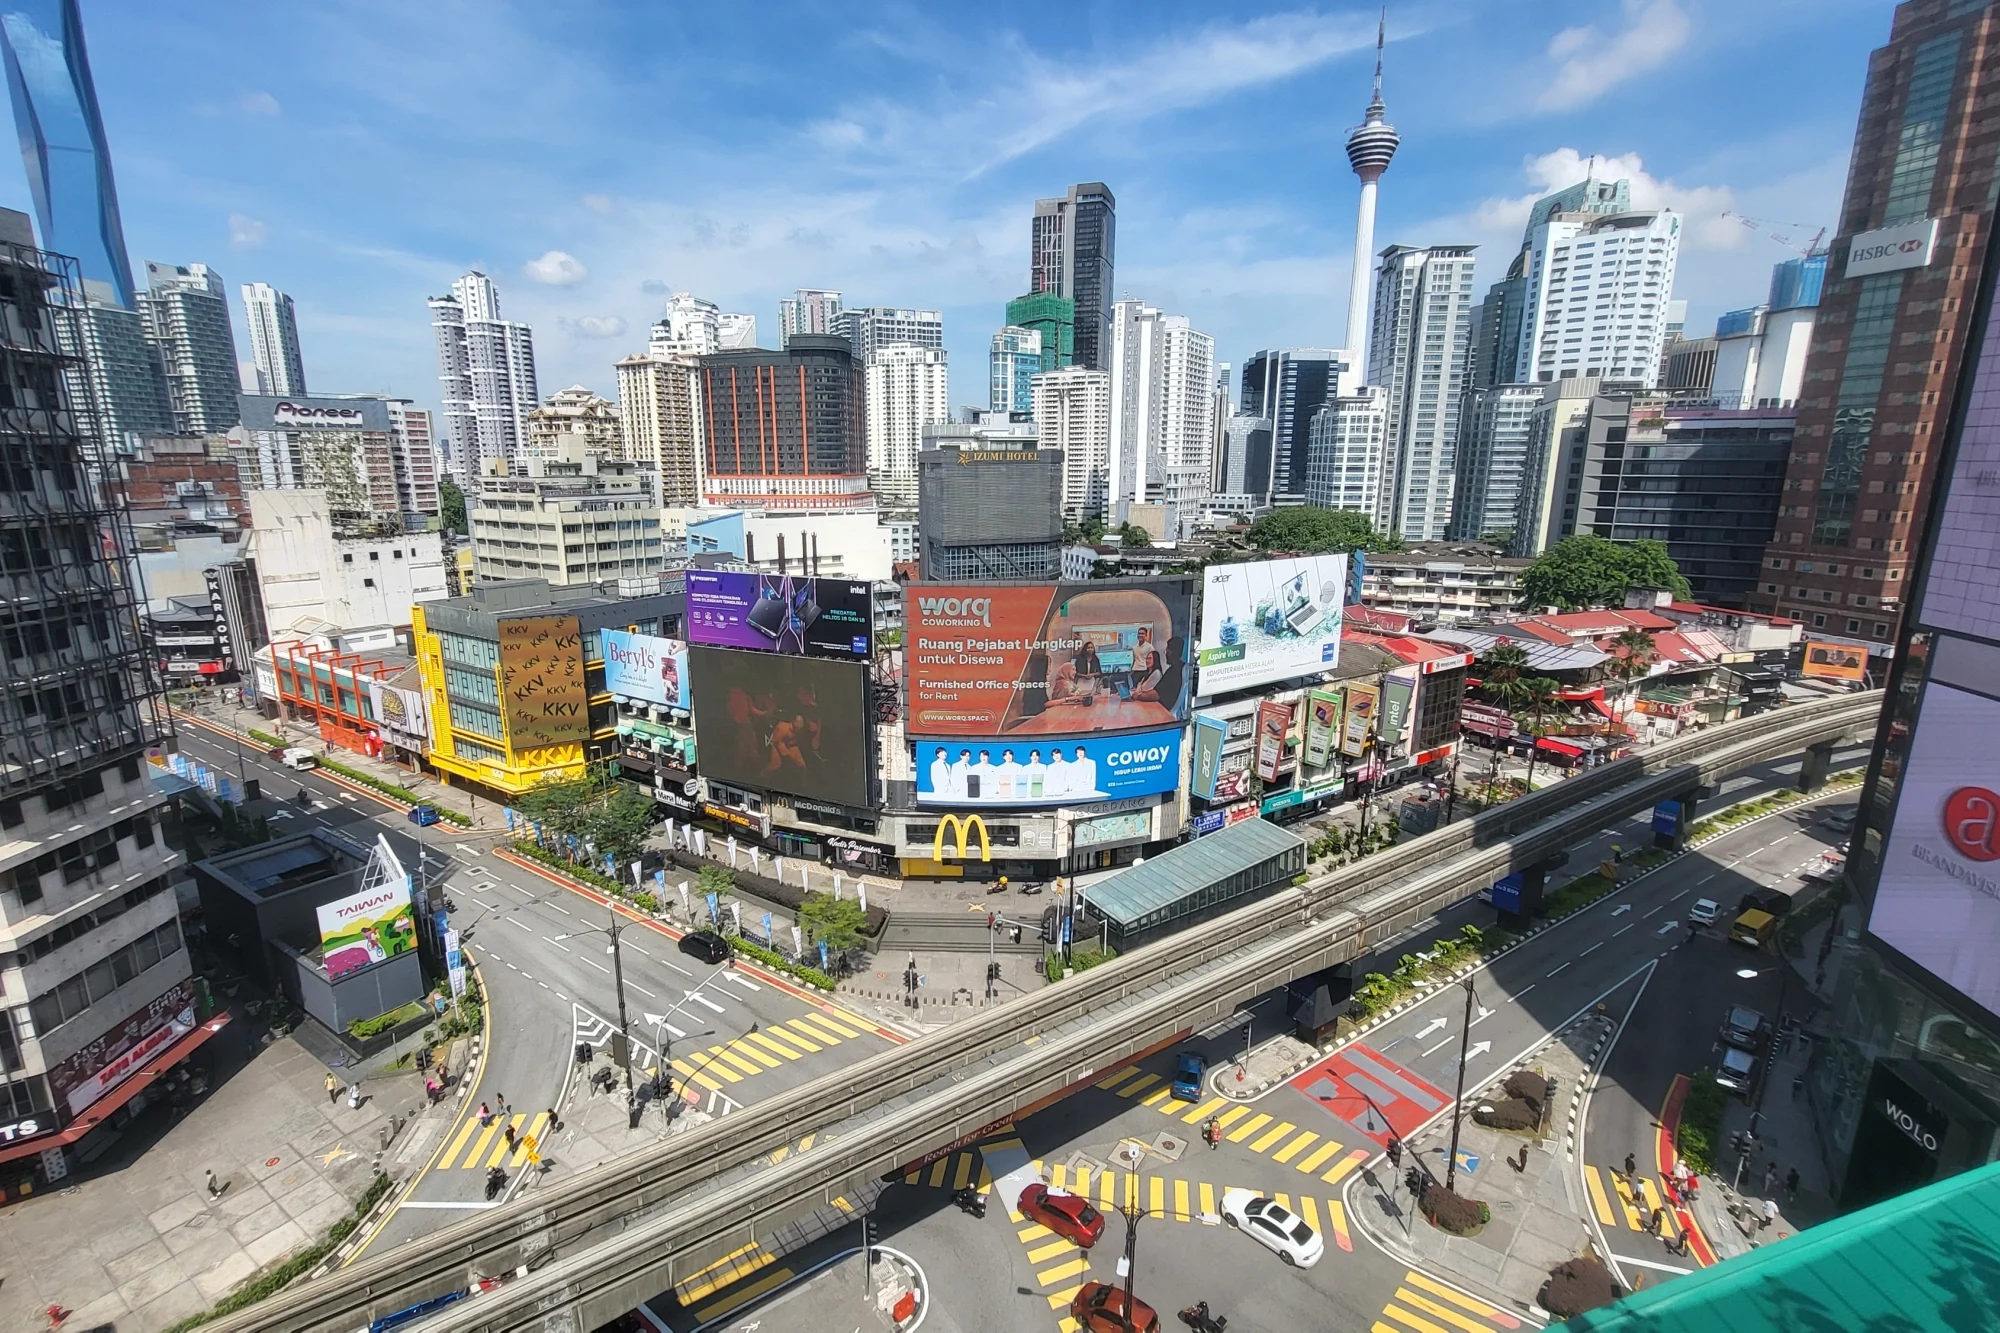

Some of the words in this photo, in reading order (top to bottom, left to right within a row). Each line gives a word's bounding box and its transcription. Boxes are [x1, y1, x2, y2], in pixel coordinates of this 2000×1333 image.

[1852, 243, 1897, 263] HSBC
[1683, 394, 1748, 406] JOURNAL
[274, 401, 362, 418] Pioneer
[974, 452, 1003, 460] IZUMI
[1006, 452, 1040, 461] HOTEL
[1211, 574, 1232, 583] acer
[850, 585, 866, 594] intel
[208, 581, 231, 655] KARAOKE
[918, 597, 992, 628] worq
[507, 625, 529, 635] KKV
[922, 618, 980, 627] COWORKING
[530, 630, 549, 648] KKV
[918, 638, 964, 653] Ruang
[966, 639, 1021, 653] Pejabat
[1024, 638, 1083, 651] Lengkap
[503, 643, 521, 651] KKV
[522, 655, 541, 671] KKV
[609, 642, 655, 673] Beryl's
[918, 654, 956, 665] untuk
[959, 654, 1004, 665] Disewa
[1207, 652, 1226, 662] Aspire
[1227, 649, 1240, 658] Vero
[545, 655, 559, 675] KKV
[564, 656, 576, 677] KKV
[1206, 666, 1233, 677] KOMPUTER
[1245, 662, 1261, 670] MESRA
[514, 675, 544, 702] KKV
[546, 686, 567, 695] KKV
[919, 680, 973, 689] Furnished
[976, 680, 1009, 689] Office
[1012, 681, 1050, 691] Spaces
[919, 692, 933, 700] for
[936, 692, 958, 700] Rent
[516, 709, 538, 723] KKV
[543, 702, 579, 716] KKV
[1388, 700, 1400, 726] intel
[923, 714, 989, 722] WWW.WORQ.SPACE
[514, 726, 528, 736] KKV
[556, 723, 573, 732] KKV
[533, 730, 554, 743] KKV
[525, 744, 573, 767] KKV
[1106, 745, 1170, 767] coway
[1201, 744, 1211, 778] acer
[1113, 768, 1131, 776] HIDUP
[1131, 766, 1147, 774] LEBIH
[1147, 764, 1162, 772] INDAH
[794, 801, 841, 815] McDonald's
[1076, 798, 1146, 817] GIORDANO
[827, 837, 848, 849] Kadir
[336, 892, 393, 917] TAIWAN
[148, 986, 183, 1018] FOOD
[73, 1036, 108, 1071] FAST
[0, 1119, 38, 1140] TS
[1886, 1099, 1937, 1150] WOLO
[923, 1139, 961, 1163] Reach
[963, 1131, 981, 1143] for
[982, 1114, 1014, 1134] Great
